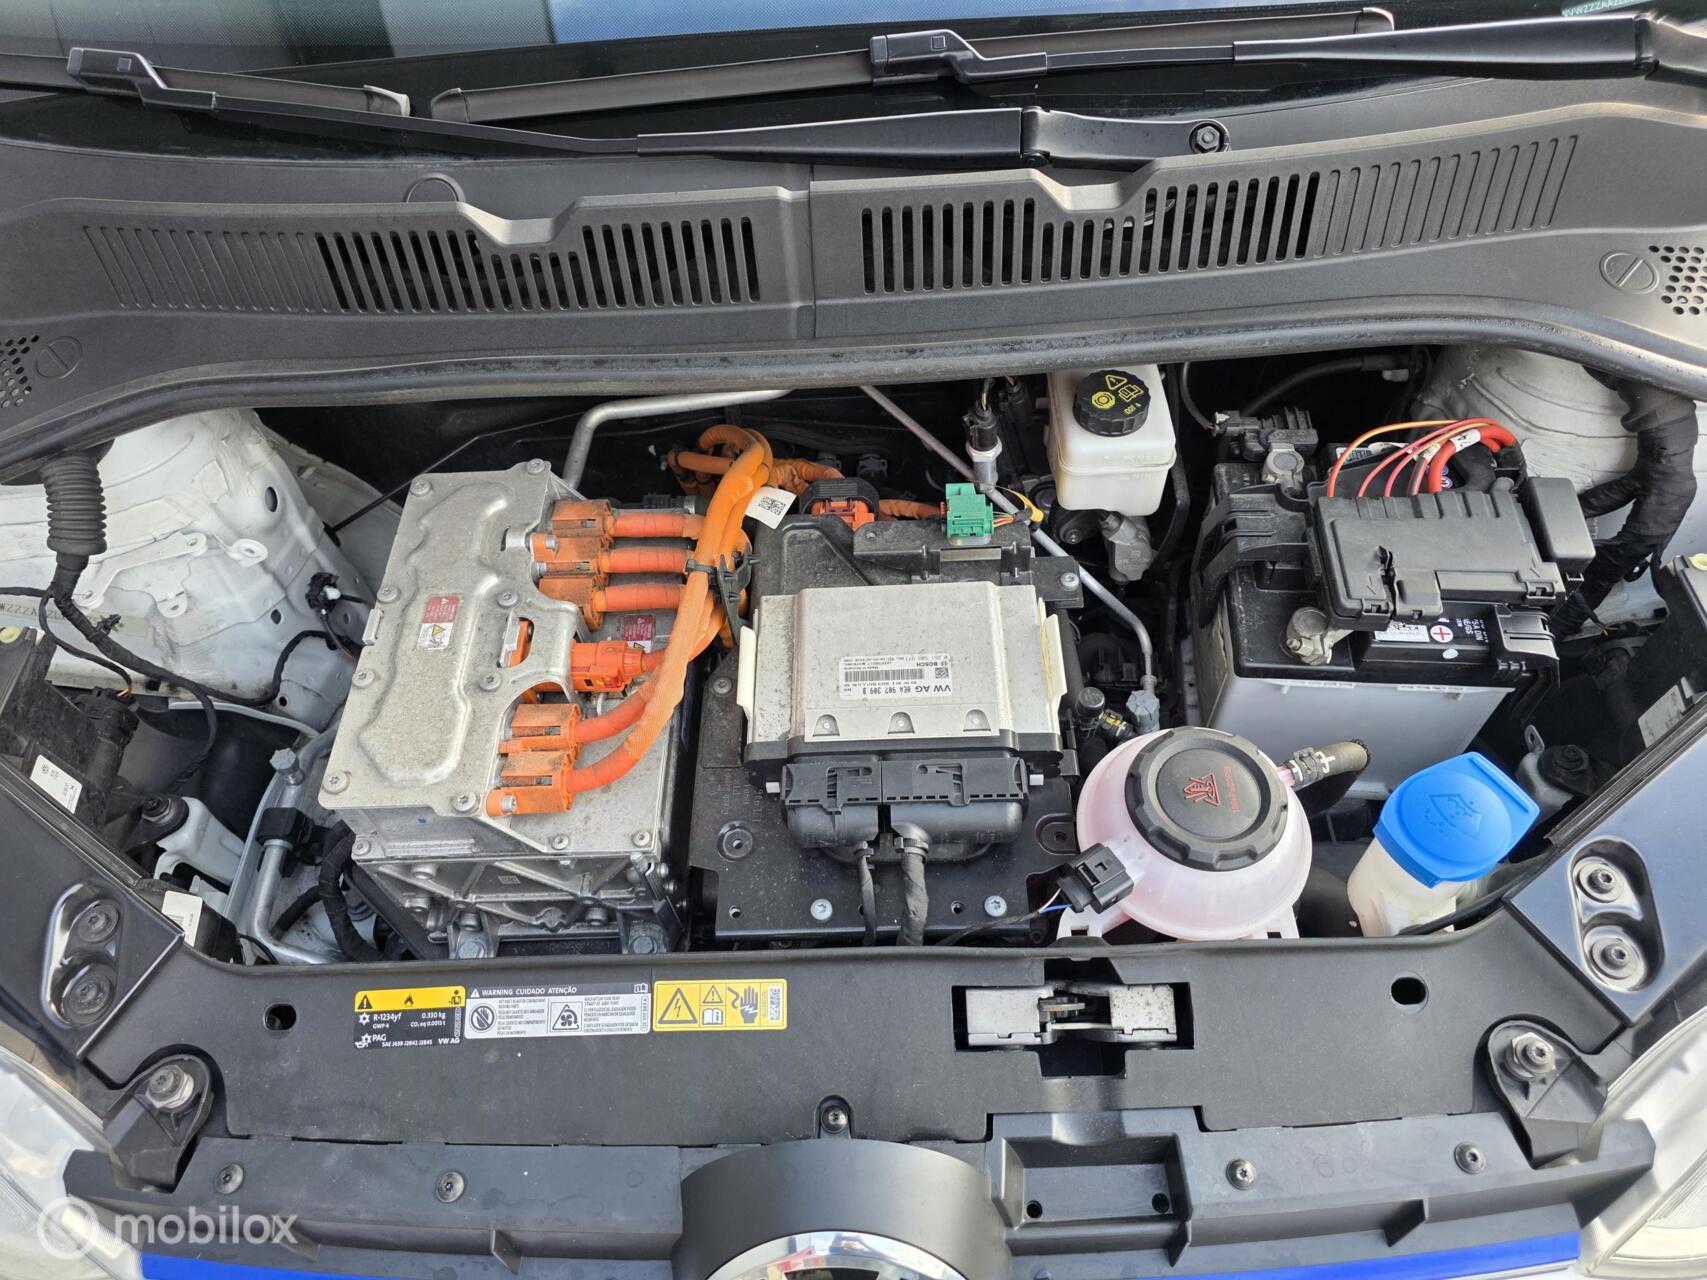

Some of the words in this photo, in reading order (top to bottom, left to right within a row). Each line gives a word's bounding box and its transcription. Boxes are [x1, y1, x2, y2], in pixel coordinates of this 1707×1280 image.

[914, 684, 931, 693] AG
[933, 684, 952, 692] VW
[515, 987, 546, 995] CUIDADO
[547, 985, 577, 995] ATENÇÃO
[373, 1012, 402, 1022] R-1234yf
[438, 1012, 446, 1020] kg
[438, 1037, 450, 1045] VW
